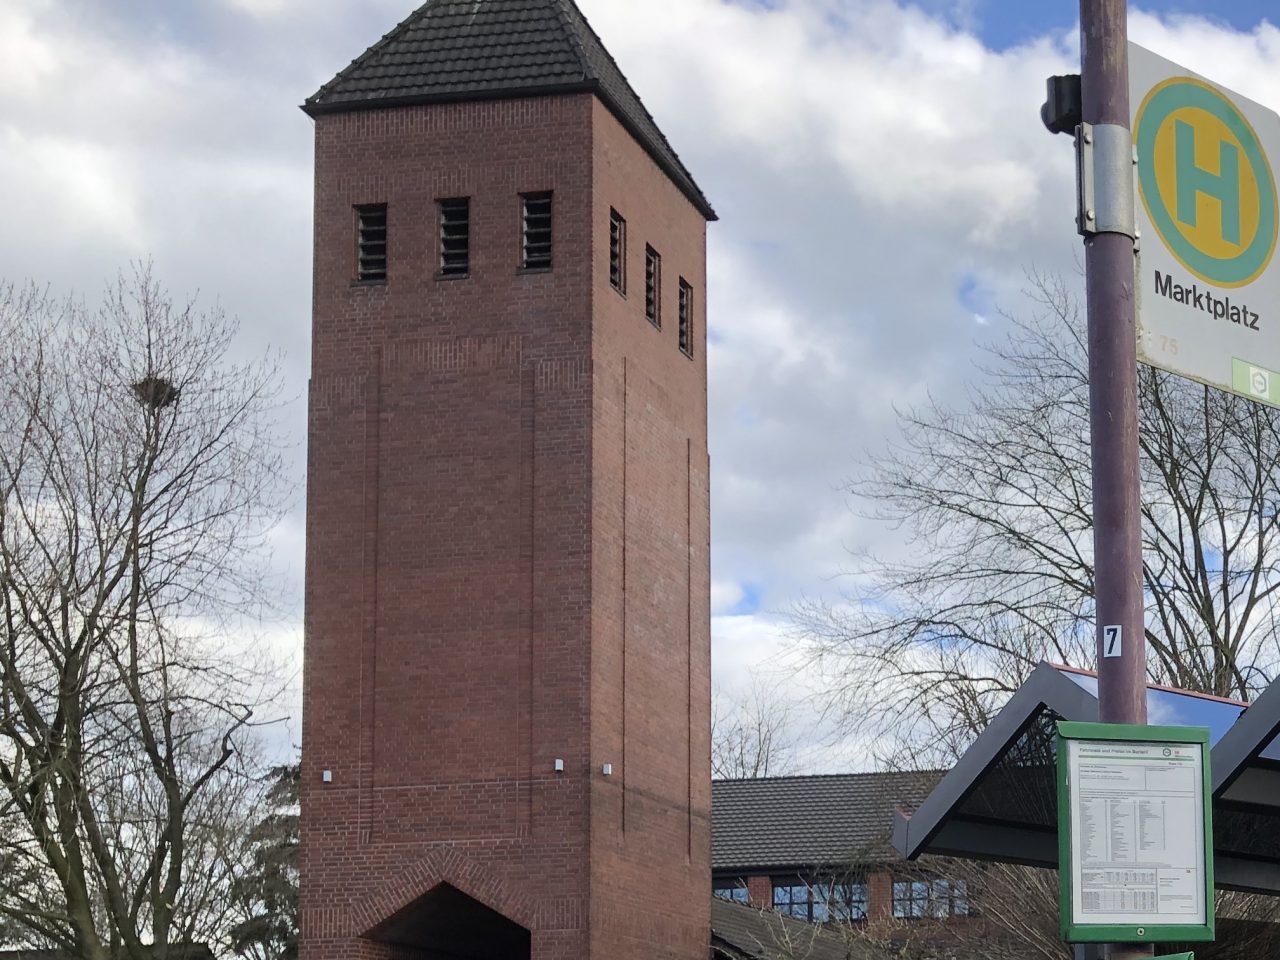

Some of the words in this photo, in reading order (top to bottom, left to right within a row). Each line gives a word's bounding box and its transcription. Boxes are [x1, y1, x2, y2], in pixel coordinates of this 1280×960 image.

[1175, 118, 1240, 246] H
[1155, 270, 1260, 331] Marktplatz
[1106, 628, 1118, 655] 7
